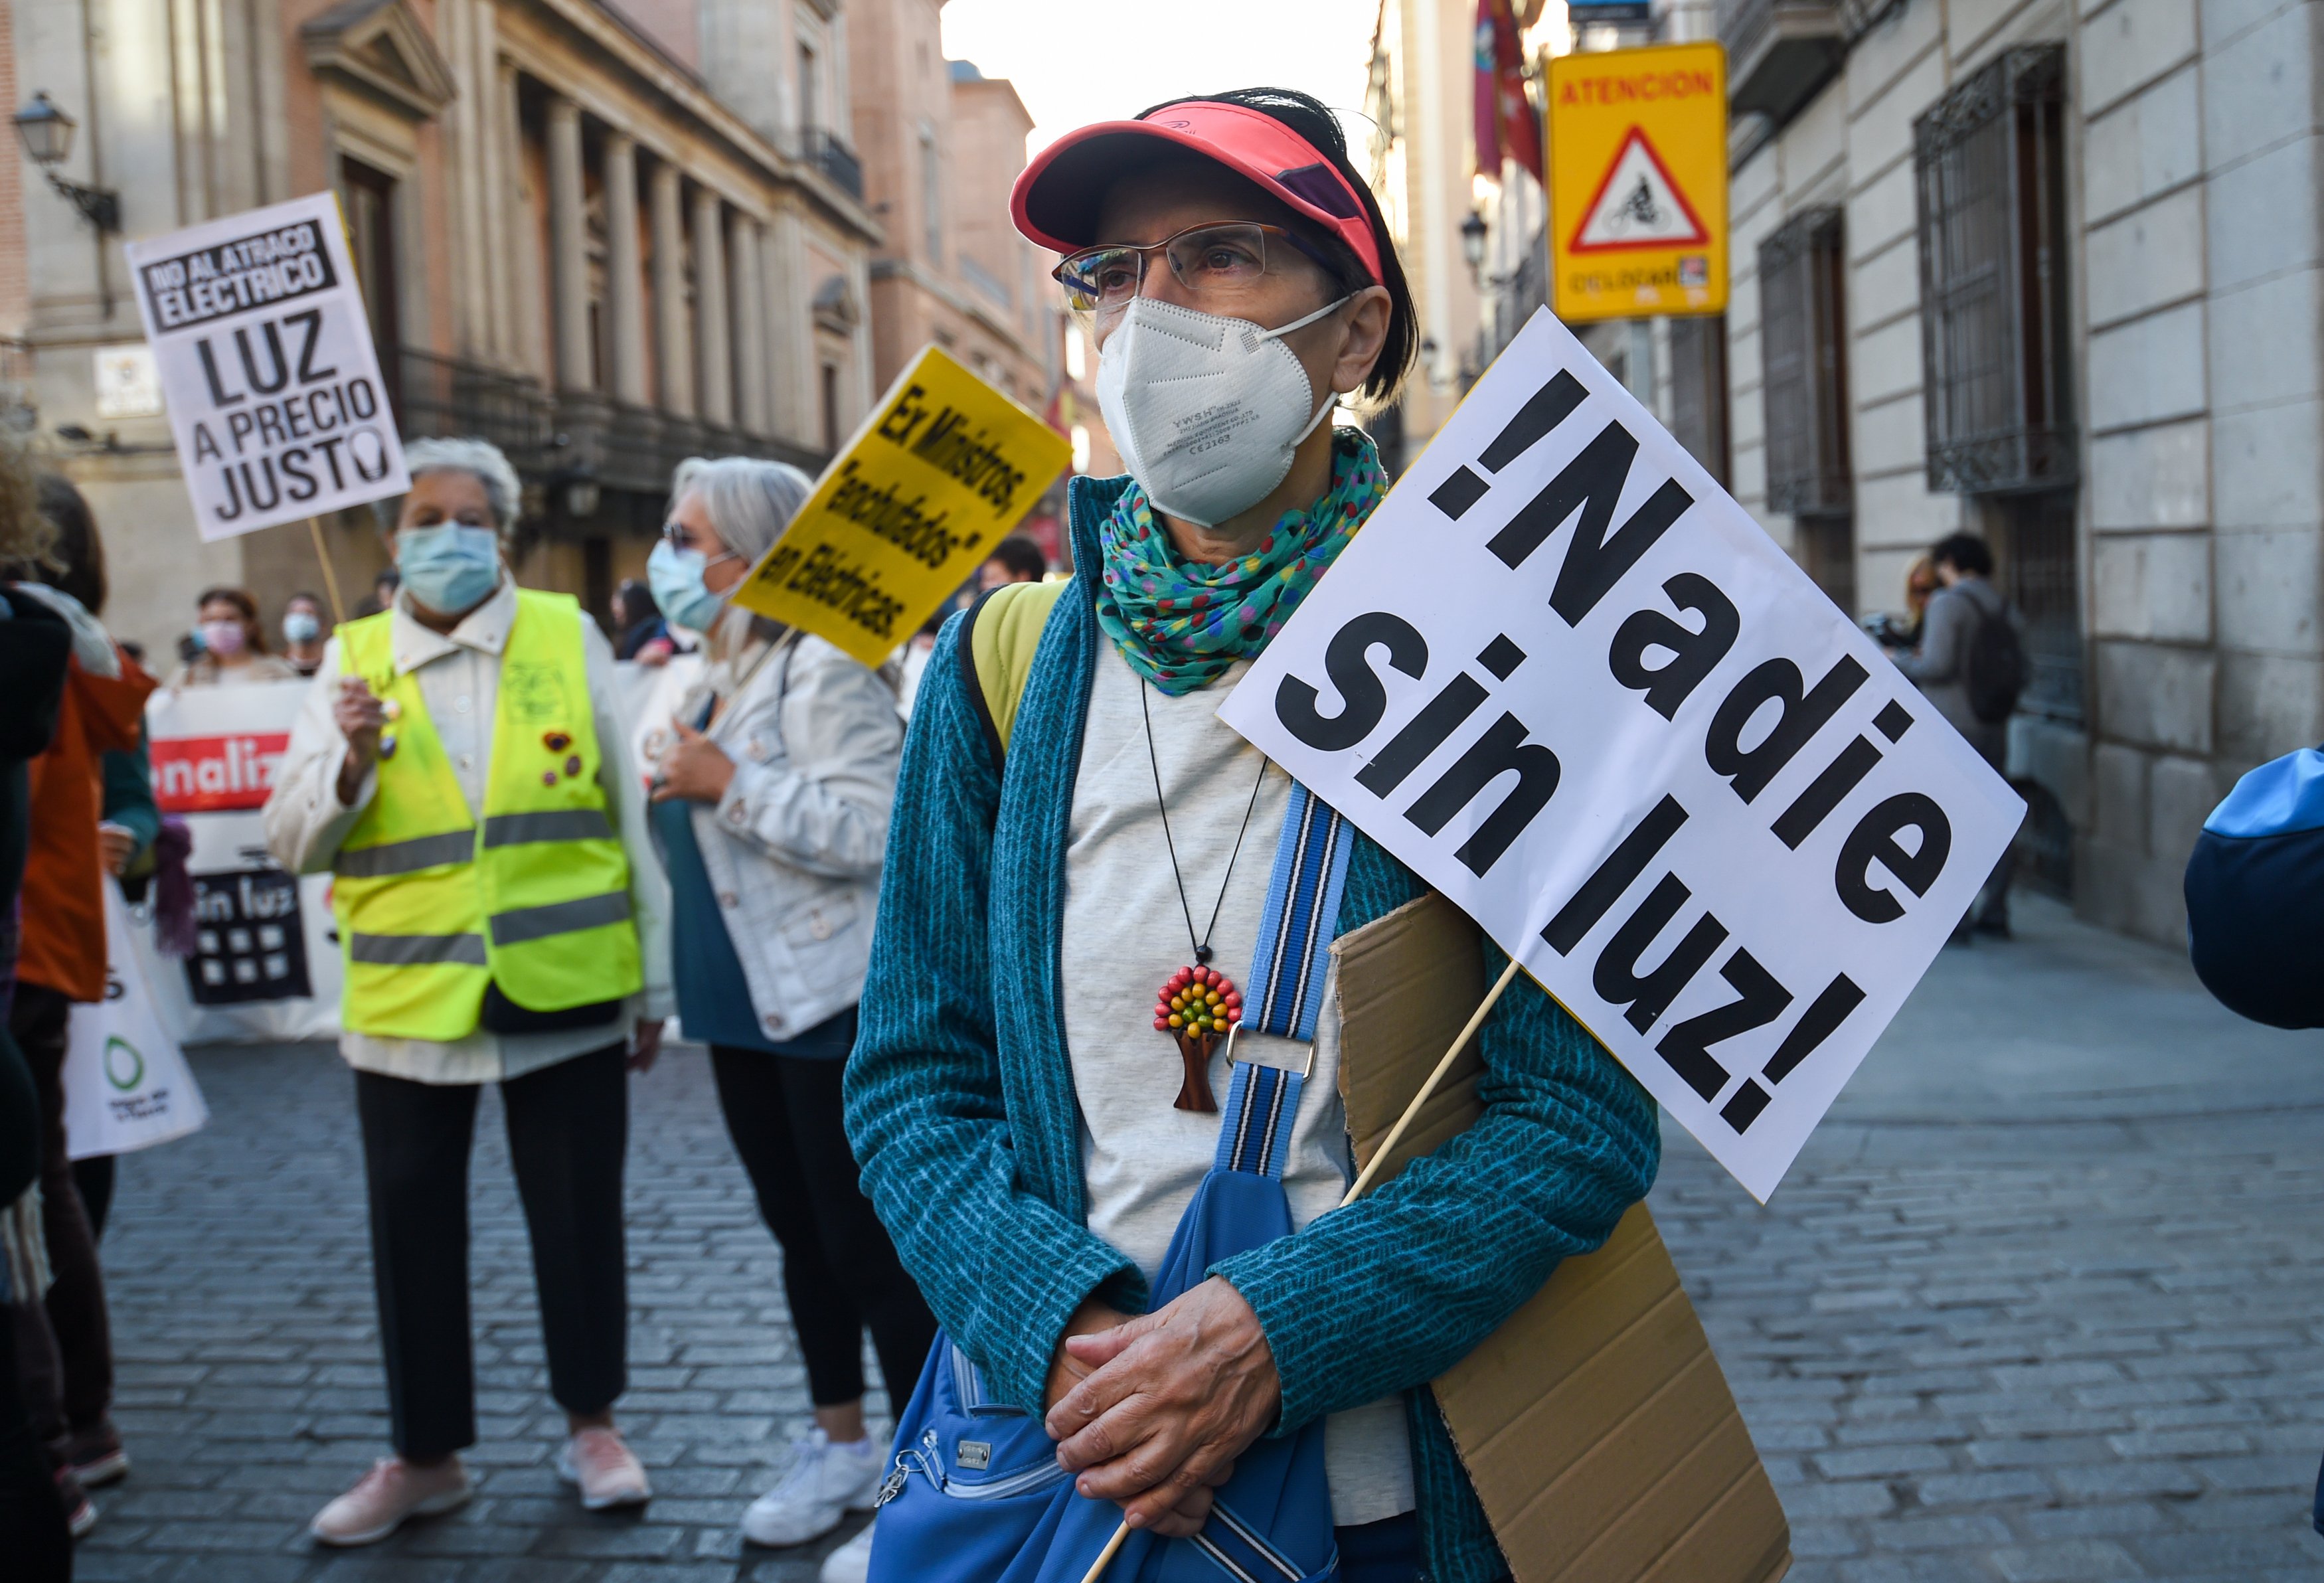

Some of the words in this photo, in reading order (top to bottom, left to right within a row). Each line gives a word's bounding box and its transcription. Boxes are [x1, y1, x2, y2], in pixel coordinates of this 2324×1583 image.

[1560, 70, 1712, 105] ATENCION
[147, 260, 187, 292] NO
[188, 252, 220, 282] AL
[220, 222, 316, 272] ATRACO
[156, 251, 325, 326] ELECTRICO
[197, 309, 336, 407] LUZ
[194, 423, 222, 464] A
[228, 378, 376, 452] PRECIO
[878, 384, 930, 447] Ex
[910, 406, 1025, 519] Ministros,
[1167, 435, 1194, 448] MEDICAL
[1195, 420, 1230, 438] EQUIPMENT
[758, 544, 800, 584] en
[1428, 368, 1951, 923] !Nadie
[1275, 612, 1561, 879] sin
[193, 880, 233, 922] in
[238, 875, 297, 920] luz
[1539, 793, 1867, 1135] luz!
